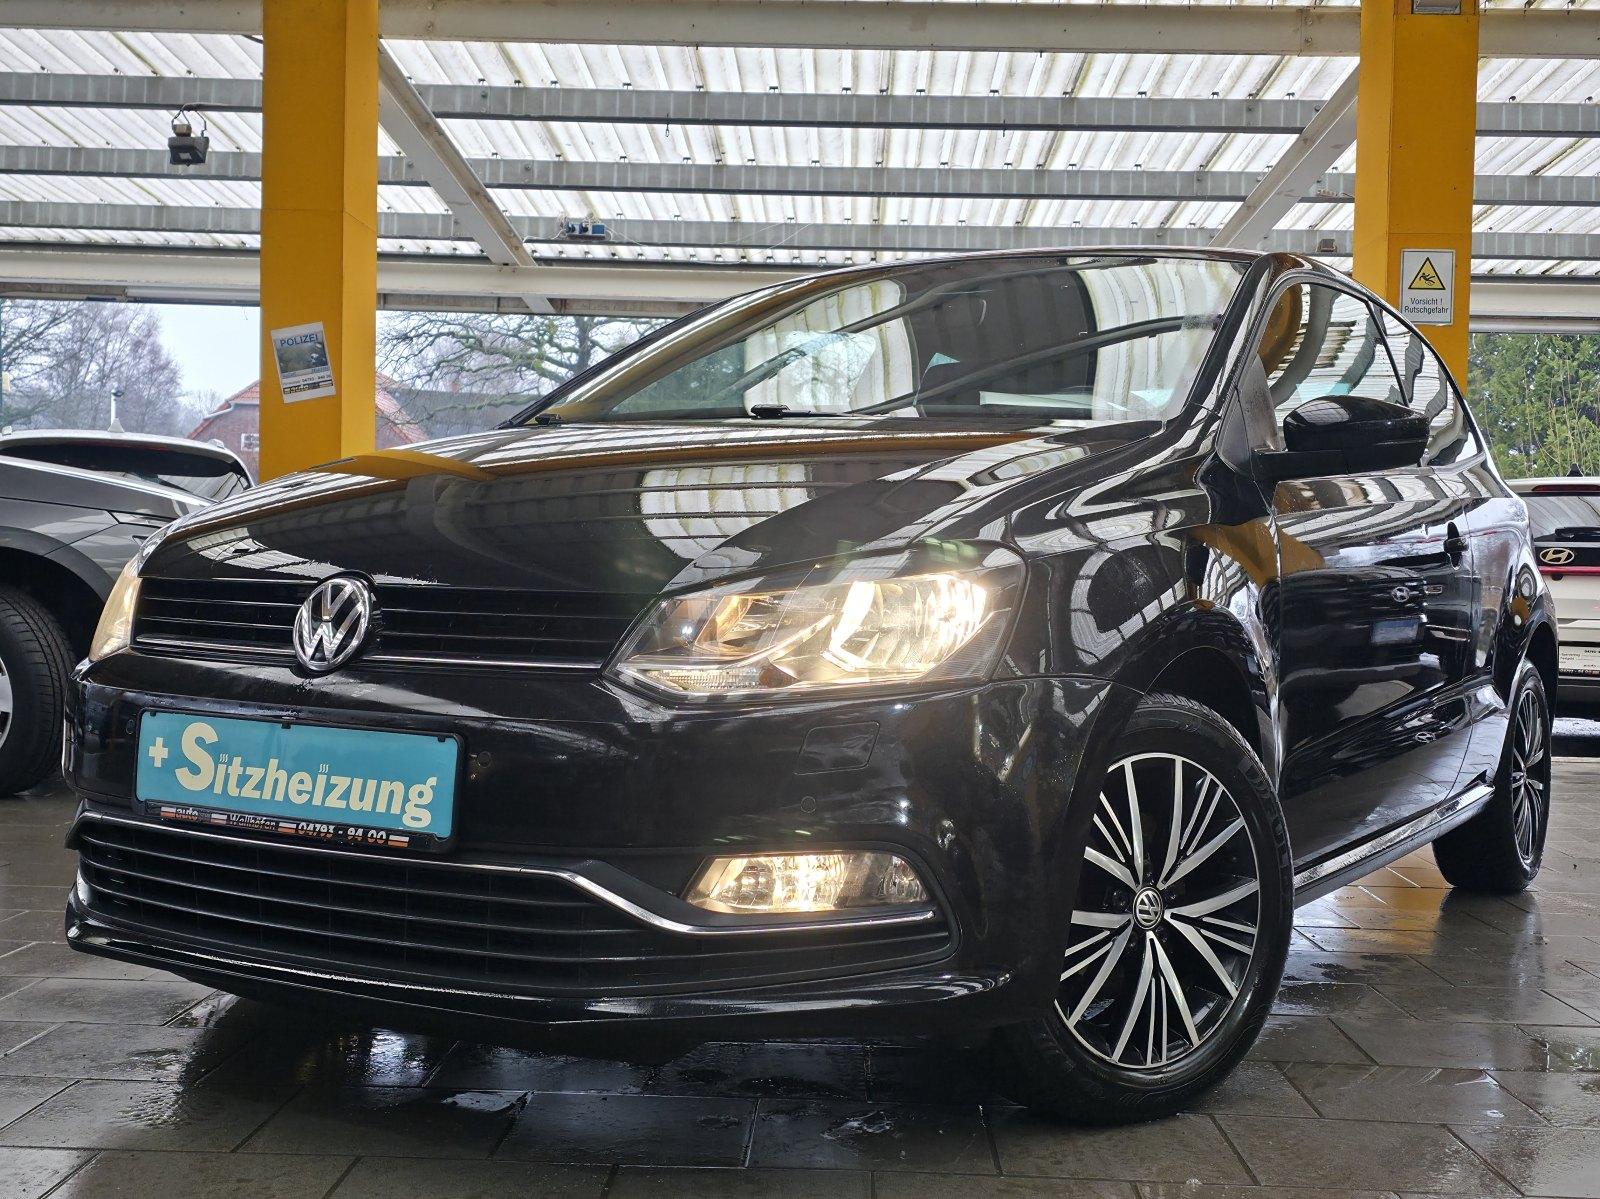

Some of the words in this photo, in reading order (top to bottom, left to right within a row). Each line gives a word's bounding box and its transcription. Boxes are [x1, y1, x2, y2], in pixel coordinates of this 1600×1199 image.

[1410, 297, 1438, 305] Vorsicht
[1404, 305, 1449, 315] Rutschgefahr
[280, 333, 319, 347] POLIZEI
[175, 722, 437, 828] Sitzheizung
